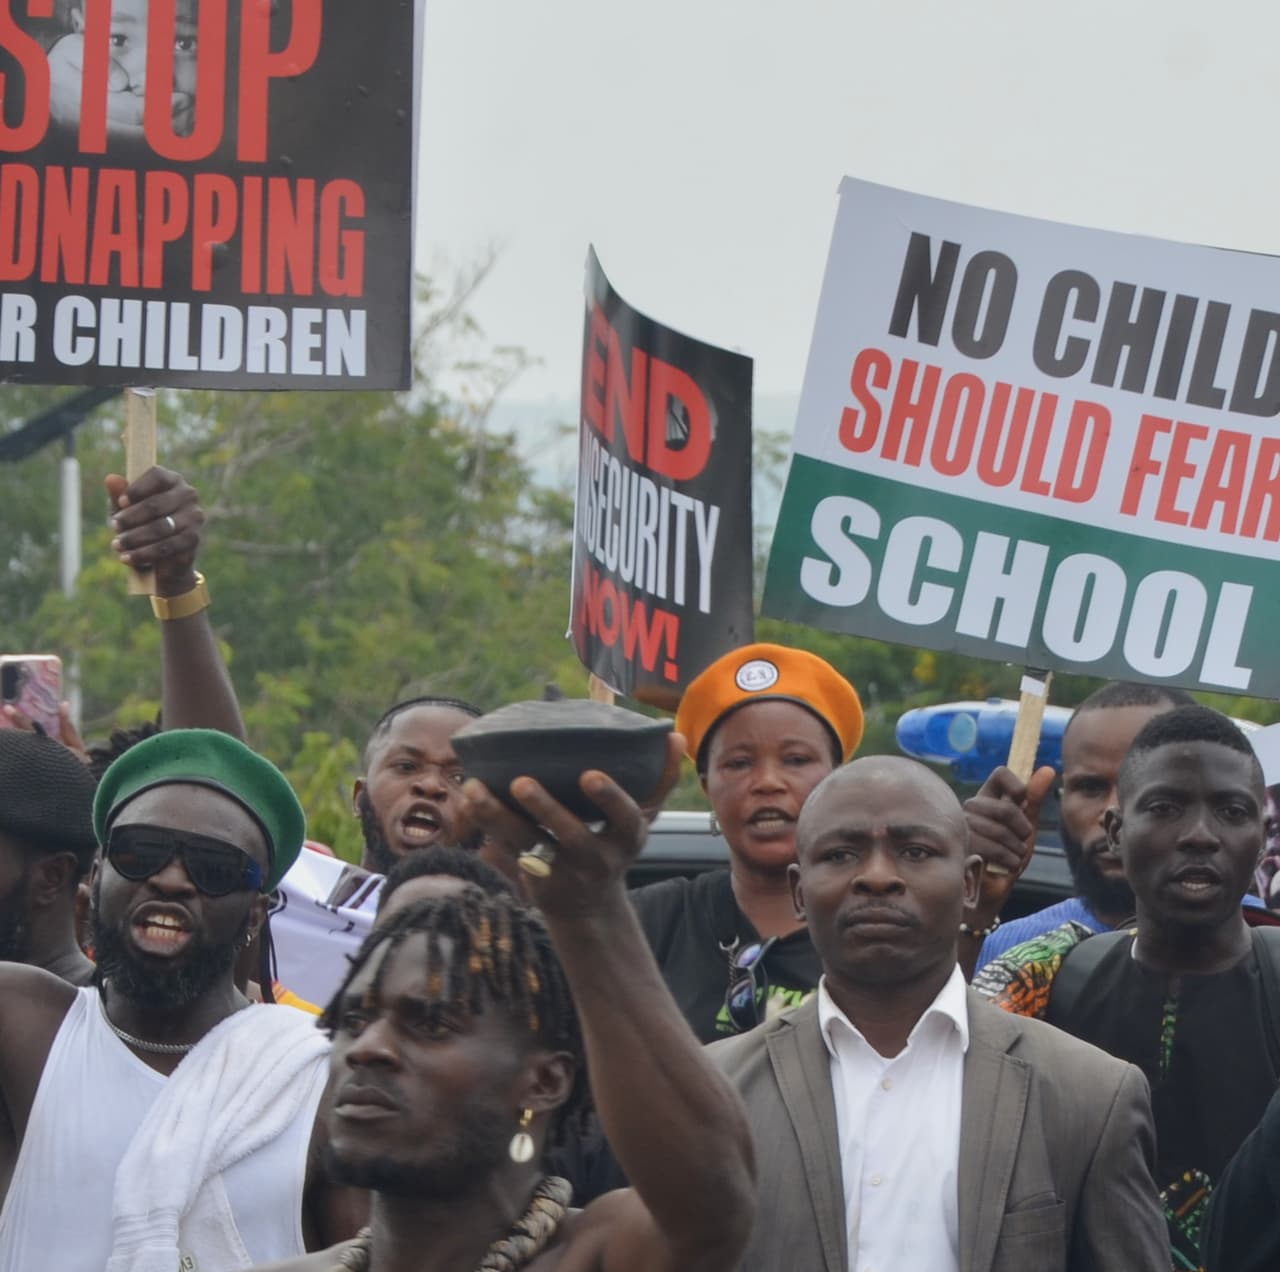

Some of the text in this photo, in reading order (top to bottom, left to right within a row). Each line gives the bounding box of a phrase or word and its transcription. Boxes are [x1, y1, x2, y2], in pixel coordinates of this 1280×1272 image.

[53, 295, 367, 377] CHILDREN
[888, 231, 1019, 360] NO
[583, 300, 713, 481] END
[837, 348, 1113, 504] SHOULD
[582, 559, 681, 683] NOW!
[800, 495, 1255, 690] SCHOOL
